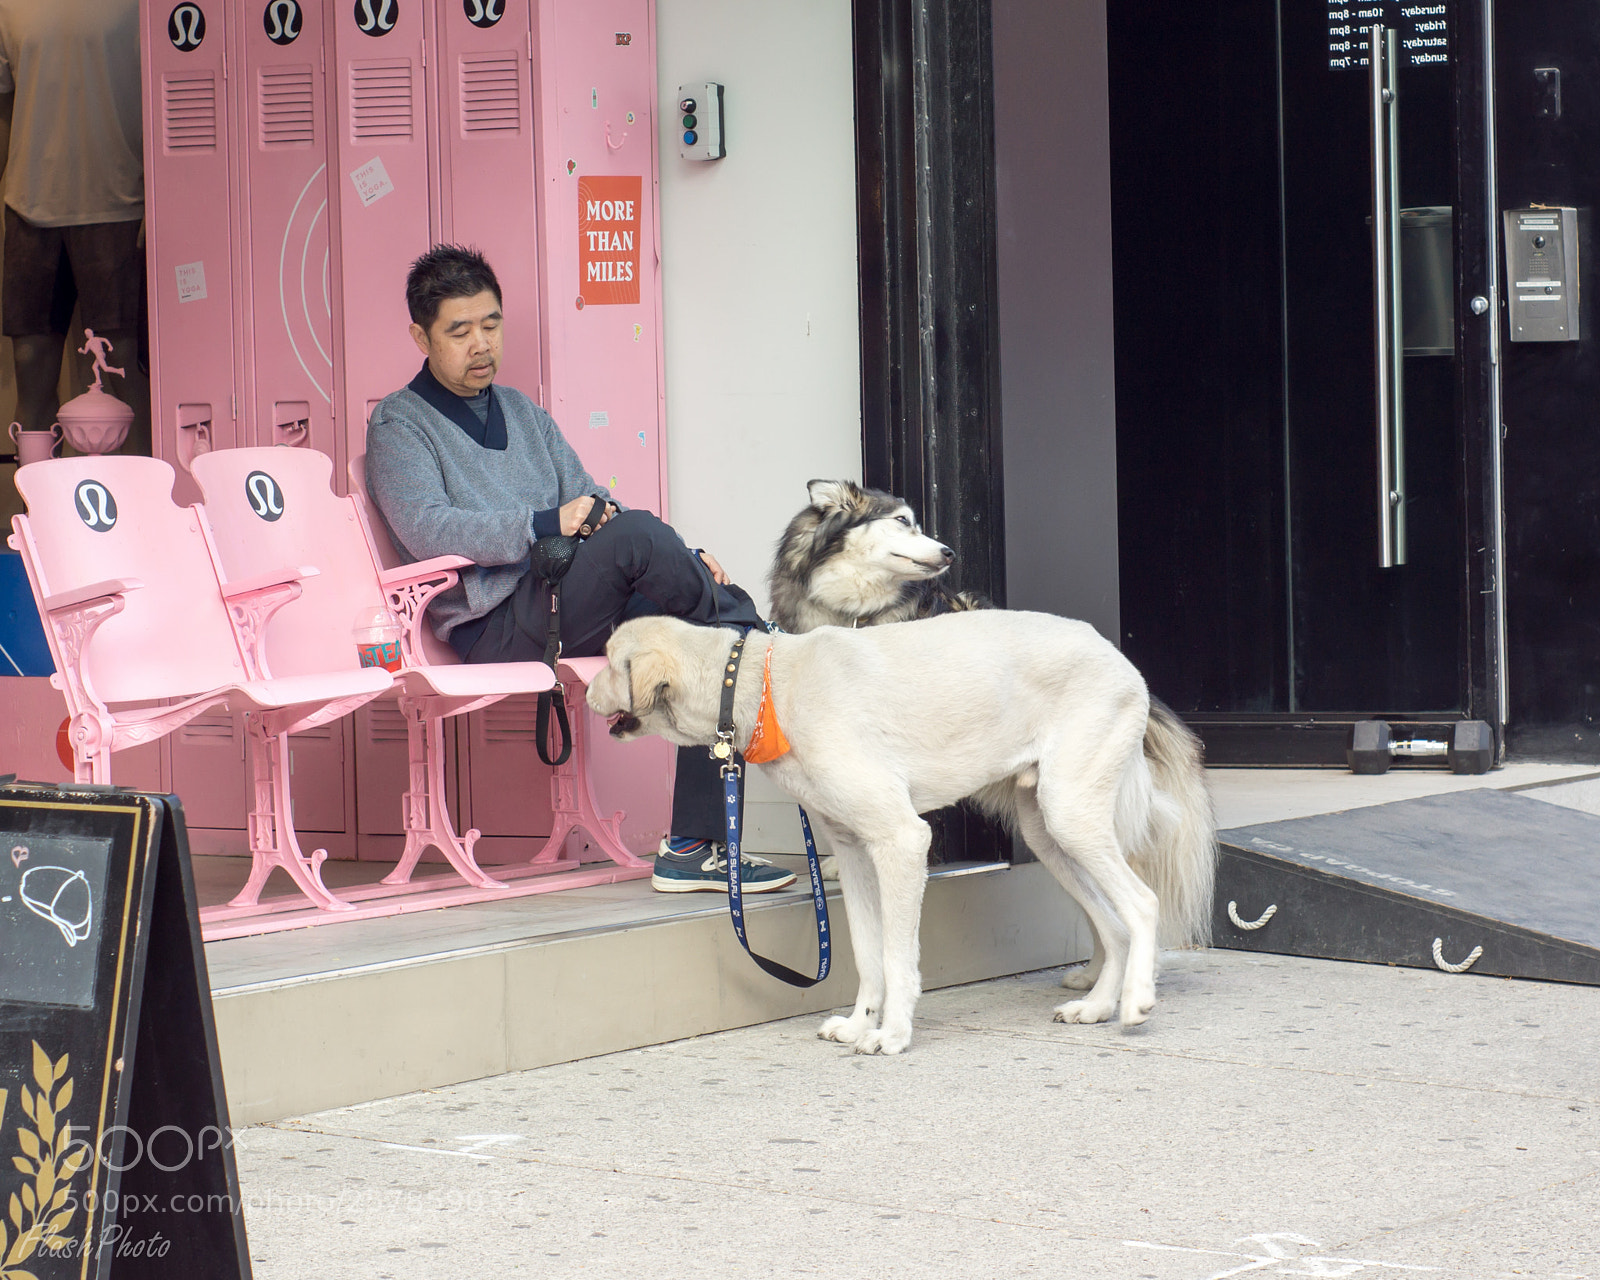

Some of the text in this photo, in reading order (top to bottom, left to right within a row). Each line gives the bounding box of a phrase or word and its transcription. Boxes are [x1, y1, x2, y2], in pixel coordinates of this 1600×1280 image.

[355, 166, 374, 180] THIS
[359, 180, 368, 190] IS
[586, 200, 634, 221] MORE
[587, 231, 634, 251] THAN
[587, 261, 633, 282] MILES
[730, 857, 738, 899] SUBARU
[809, 857, 822, 897] SUBARU
